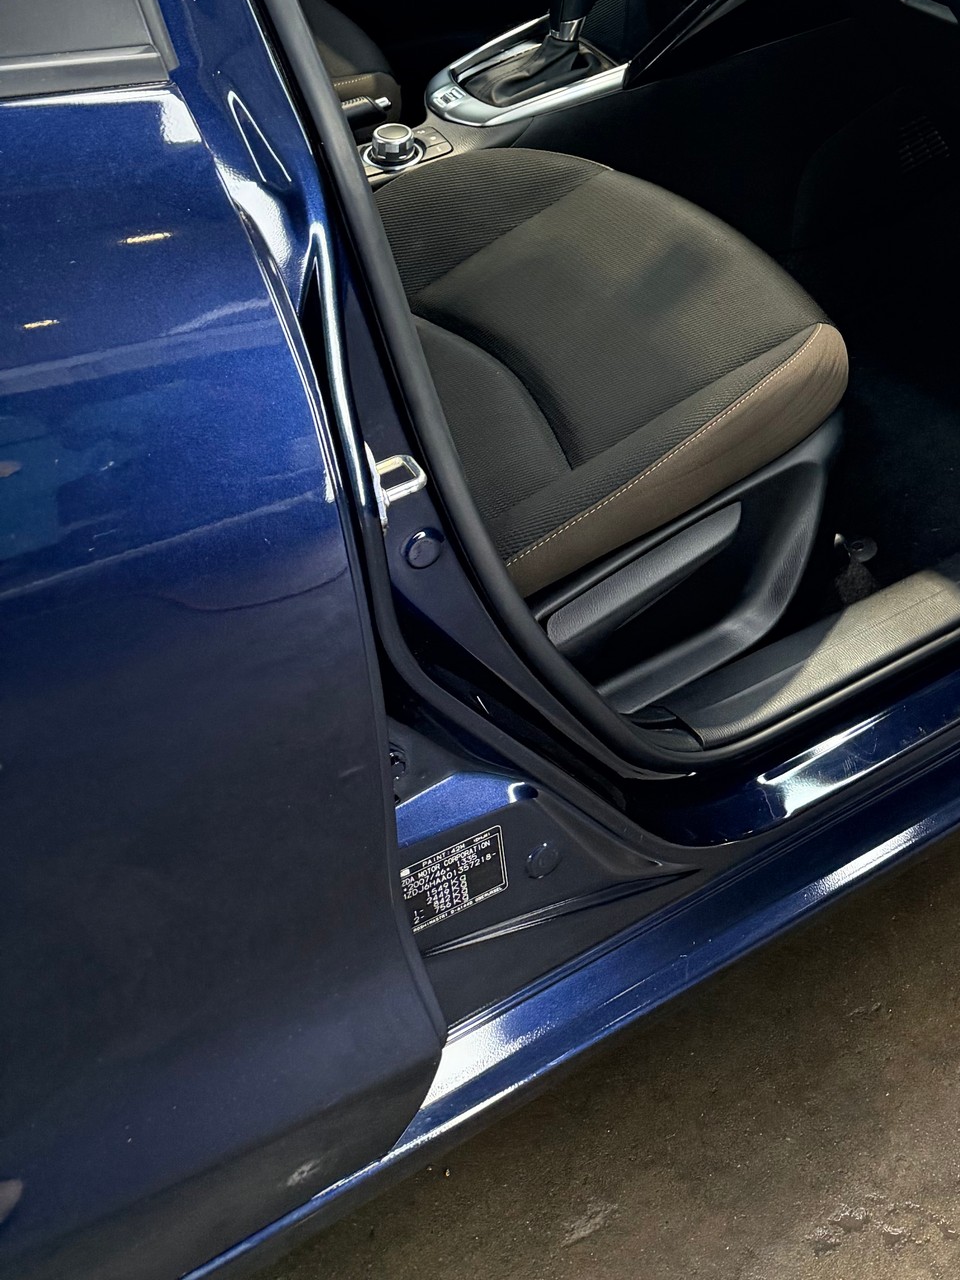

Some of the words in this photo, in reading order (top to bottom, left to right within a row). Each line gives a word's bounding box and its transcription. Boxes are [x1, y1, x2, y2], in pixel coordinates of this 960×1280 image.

[401, 876, 415, 887] ZDA
[418, 864, 440, 878] MOTOR
[443, 840, 491, 866] CORPORATION
